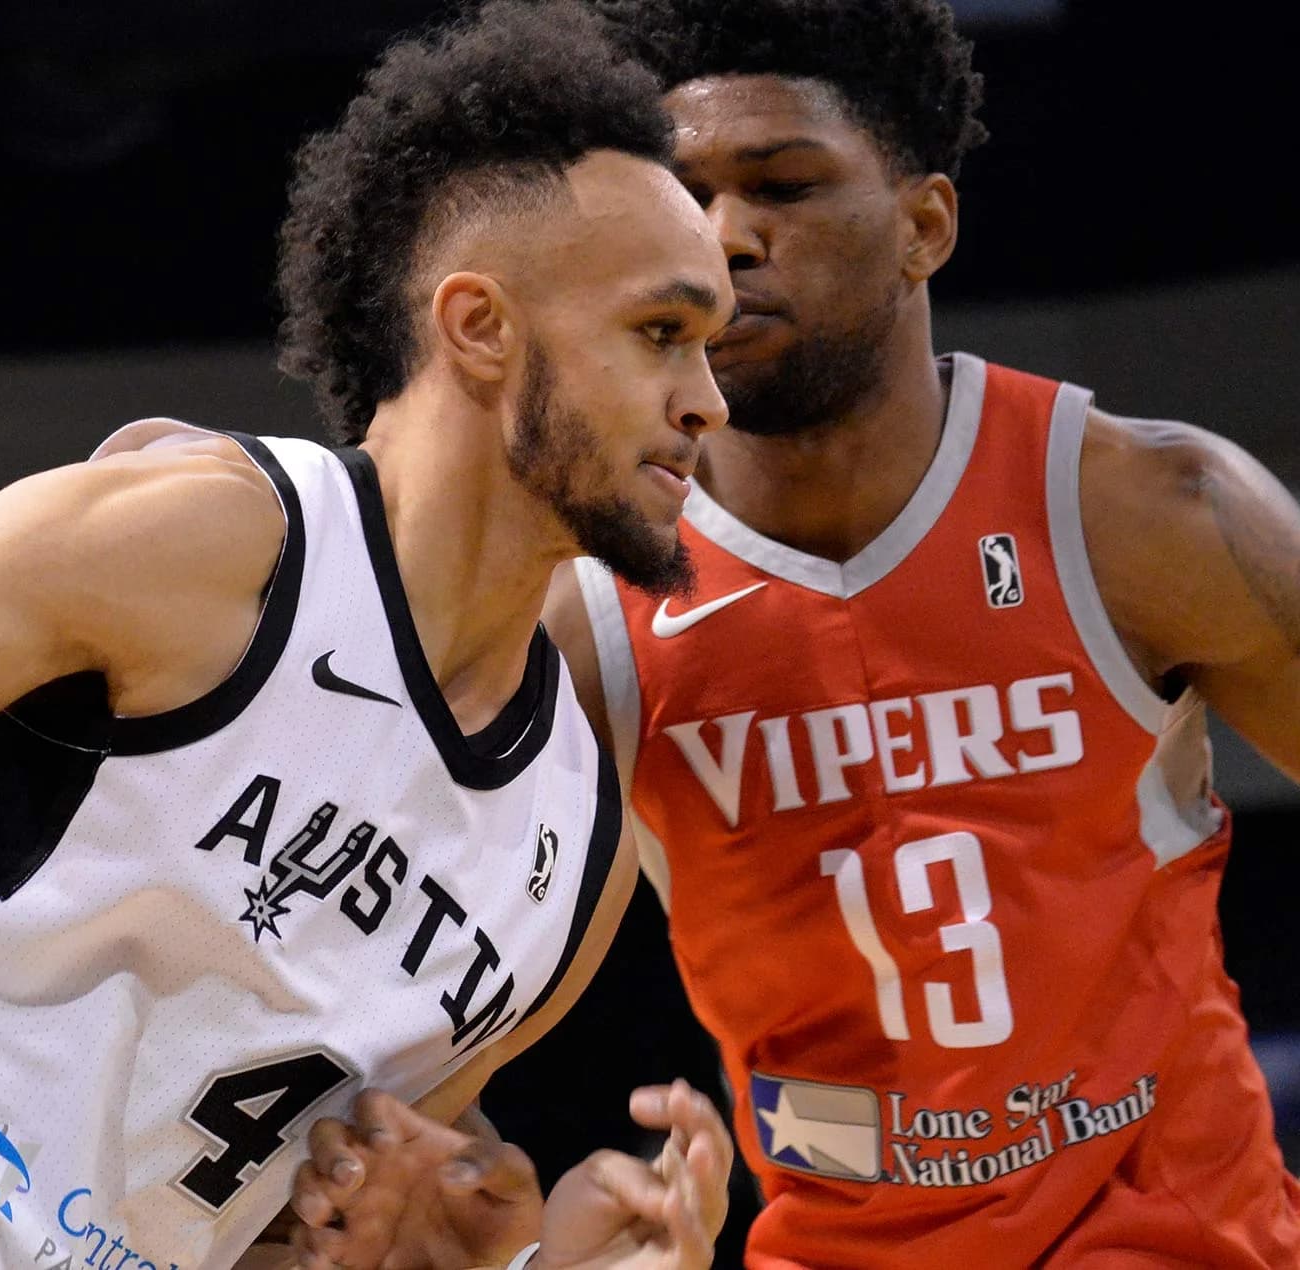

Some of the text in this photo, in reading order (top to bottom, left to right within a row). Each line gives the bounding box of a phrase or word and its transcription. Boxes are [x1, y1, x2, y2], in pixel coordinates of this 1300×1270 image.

[662, 672, 1085, 827] VIPERS
[194, 773, 517, 1066] AUSTIN
[820, 831, 1014, 1049] 13
[168, 1045, 362, 1216] 4
[888, 1069, 1076, 1139] Lone Star
[890, 1073, 1157, 1187] National Bank
